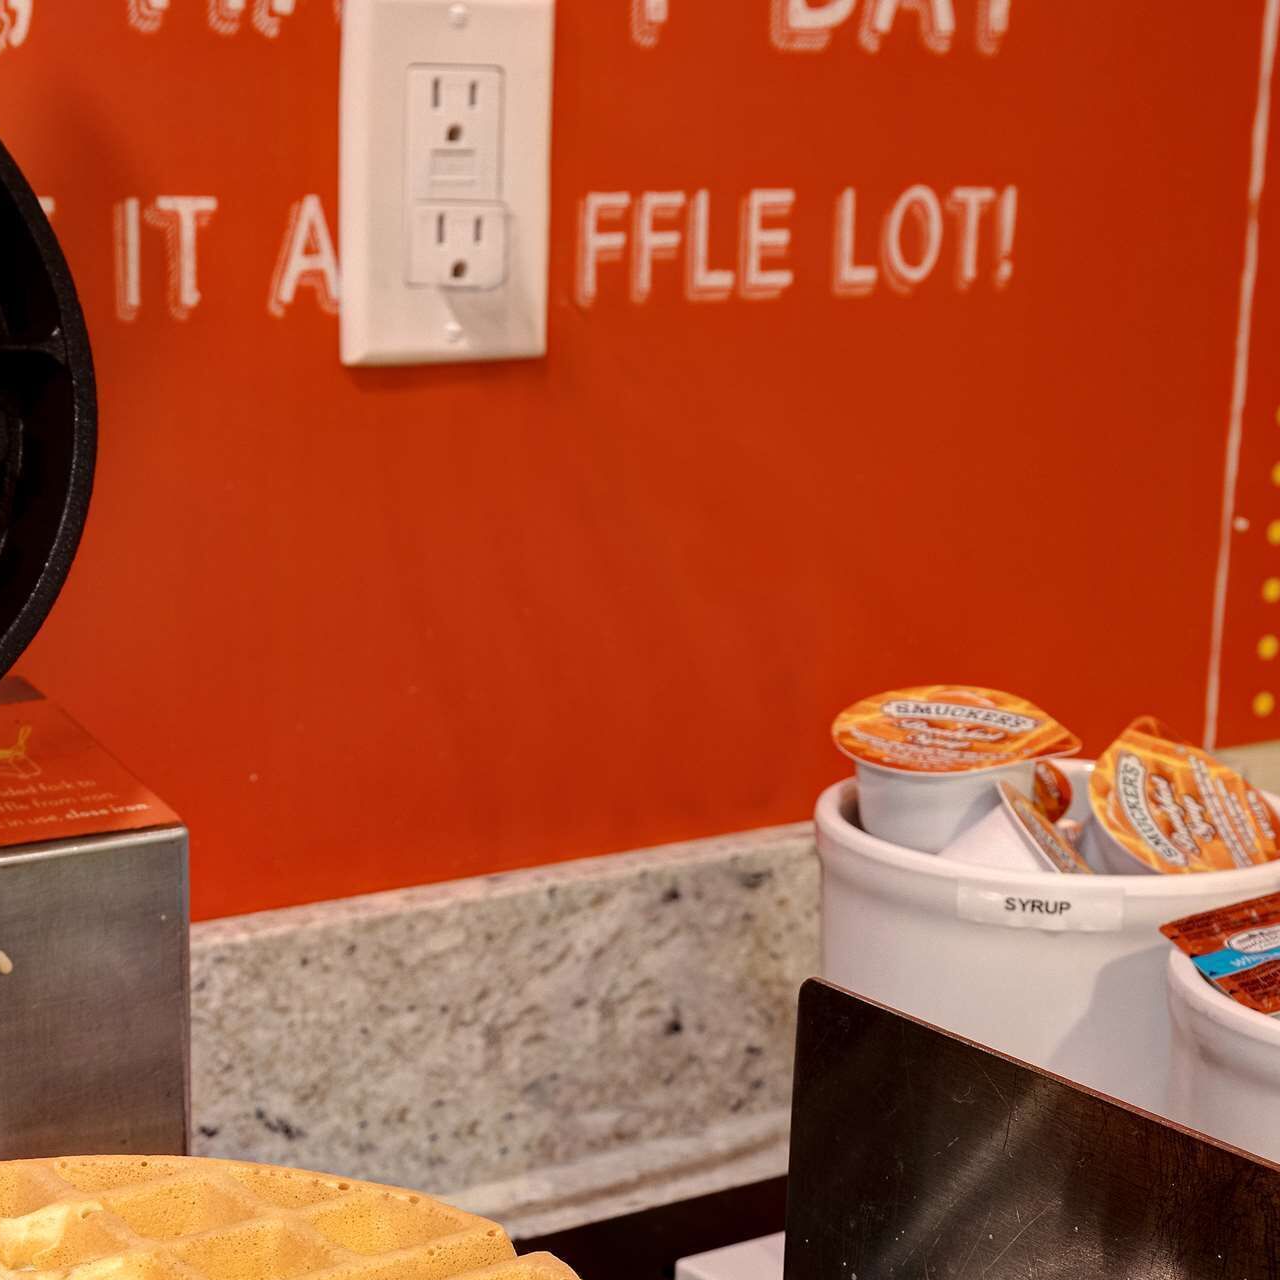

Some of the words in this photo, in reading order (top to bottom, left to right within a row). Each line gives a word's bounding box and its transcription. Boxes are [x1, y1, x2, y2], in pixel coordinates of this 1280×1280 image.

[114, 195, 217, 320] IT
[268, 194, 340, 317] A
[577, 188, 796, 305] FFLE
[832, 184, 1018, 296] LOT!
[1004, 896, 1072, 917] SYRUP
